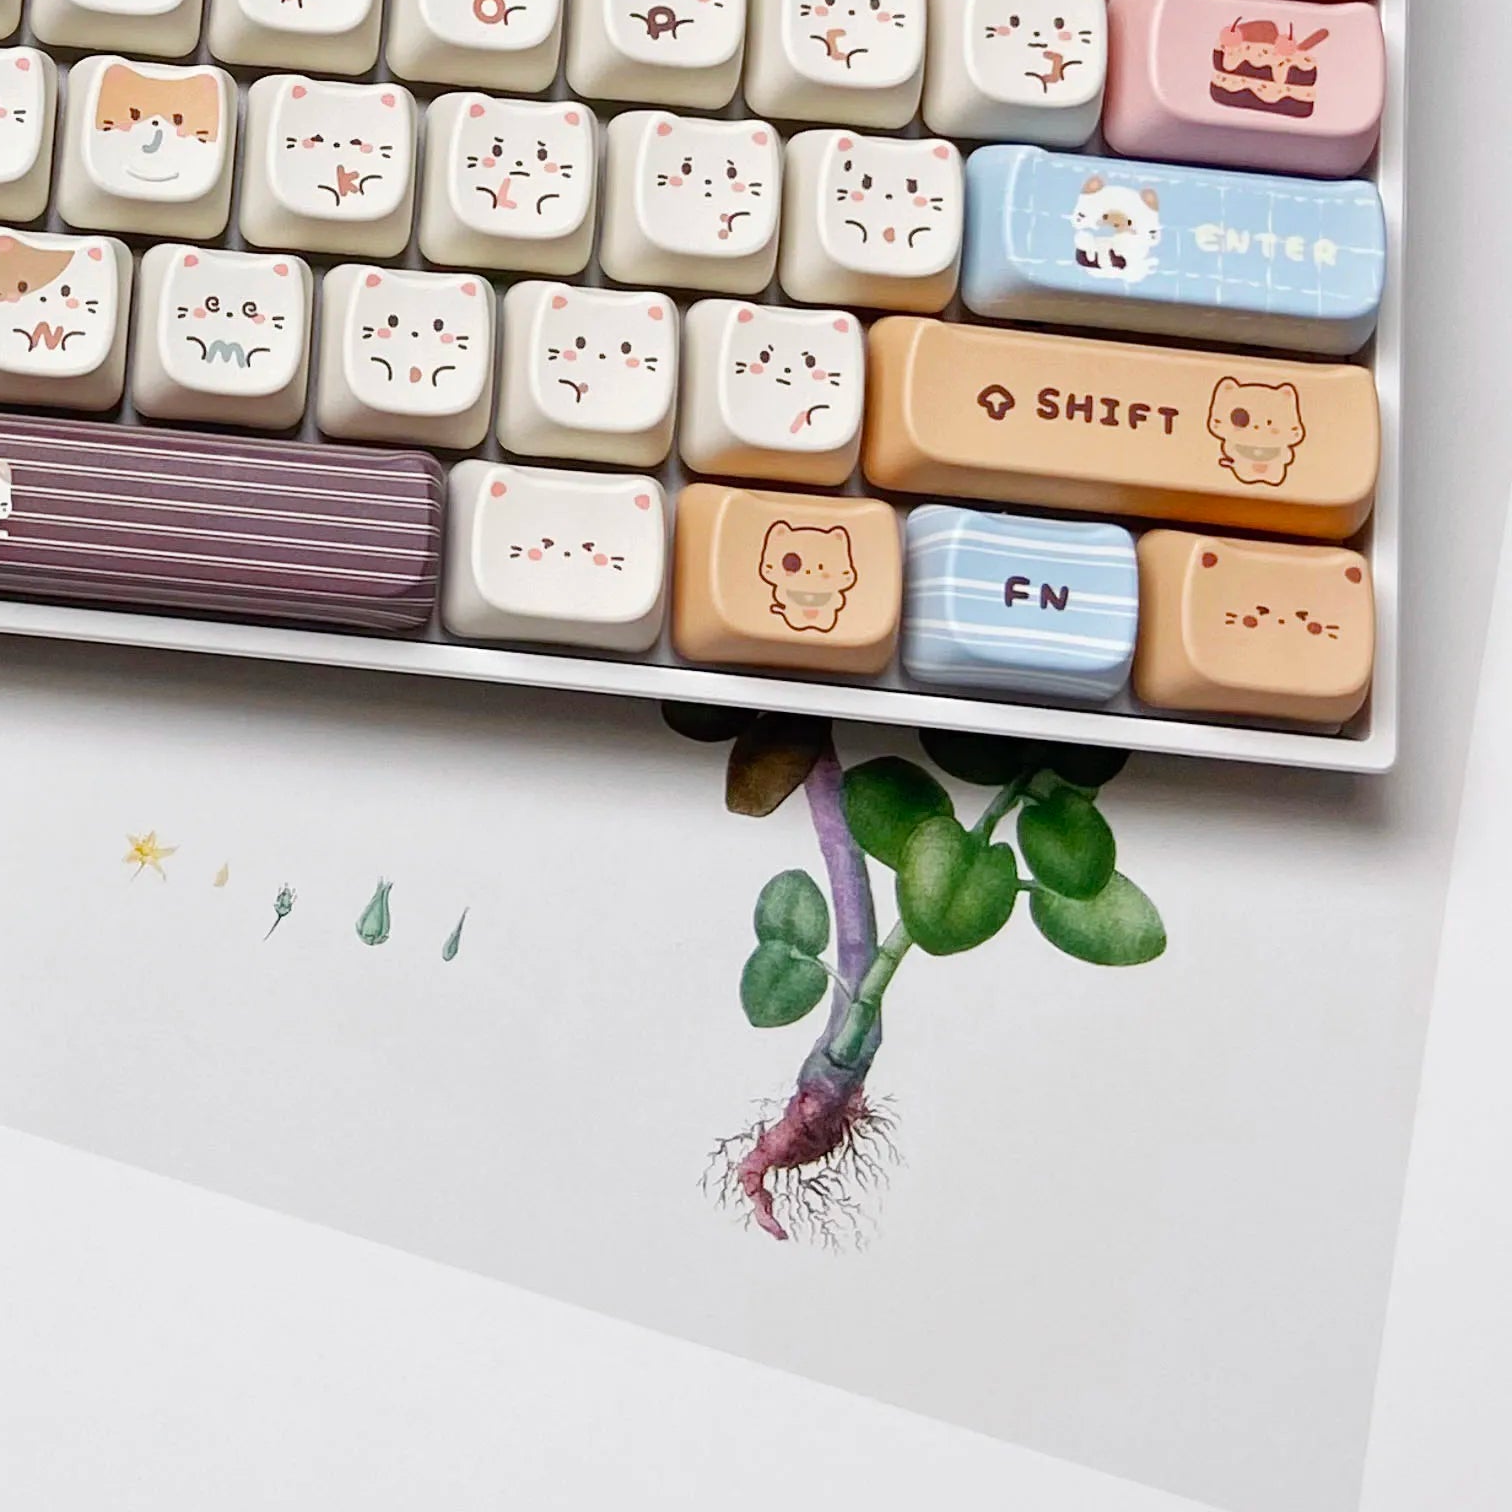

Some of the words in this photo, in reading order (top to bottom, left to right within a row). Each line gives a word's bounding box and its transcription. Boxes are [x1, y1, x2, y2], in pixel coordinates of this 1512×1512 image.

[647, 6, 677, 40] P
[141, 128, 163, 153] J
[336, 164, 361, 197] K
[495, 177, 517, 209] L
[1195, 223, 1338, 266] ENTER
[30, 321, 65, 350] N
[206, 339, 246, 368] M
[1036, 388, 1180, 435] SHIFT
[1004, 576, 1070, 612] FN
